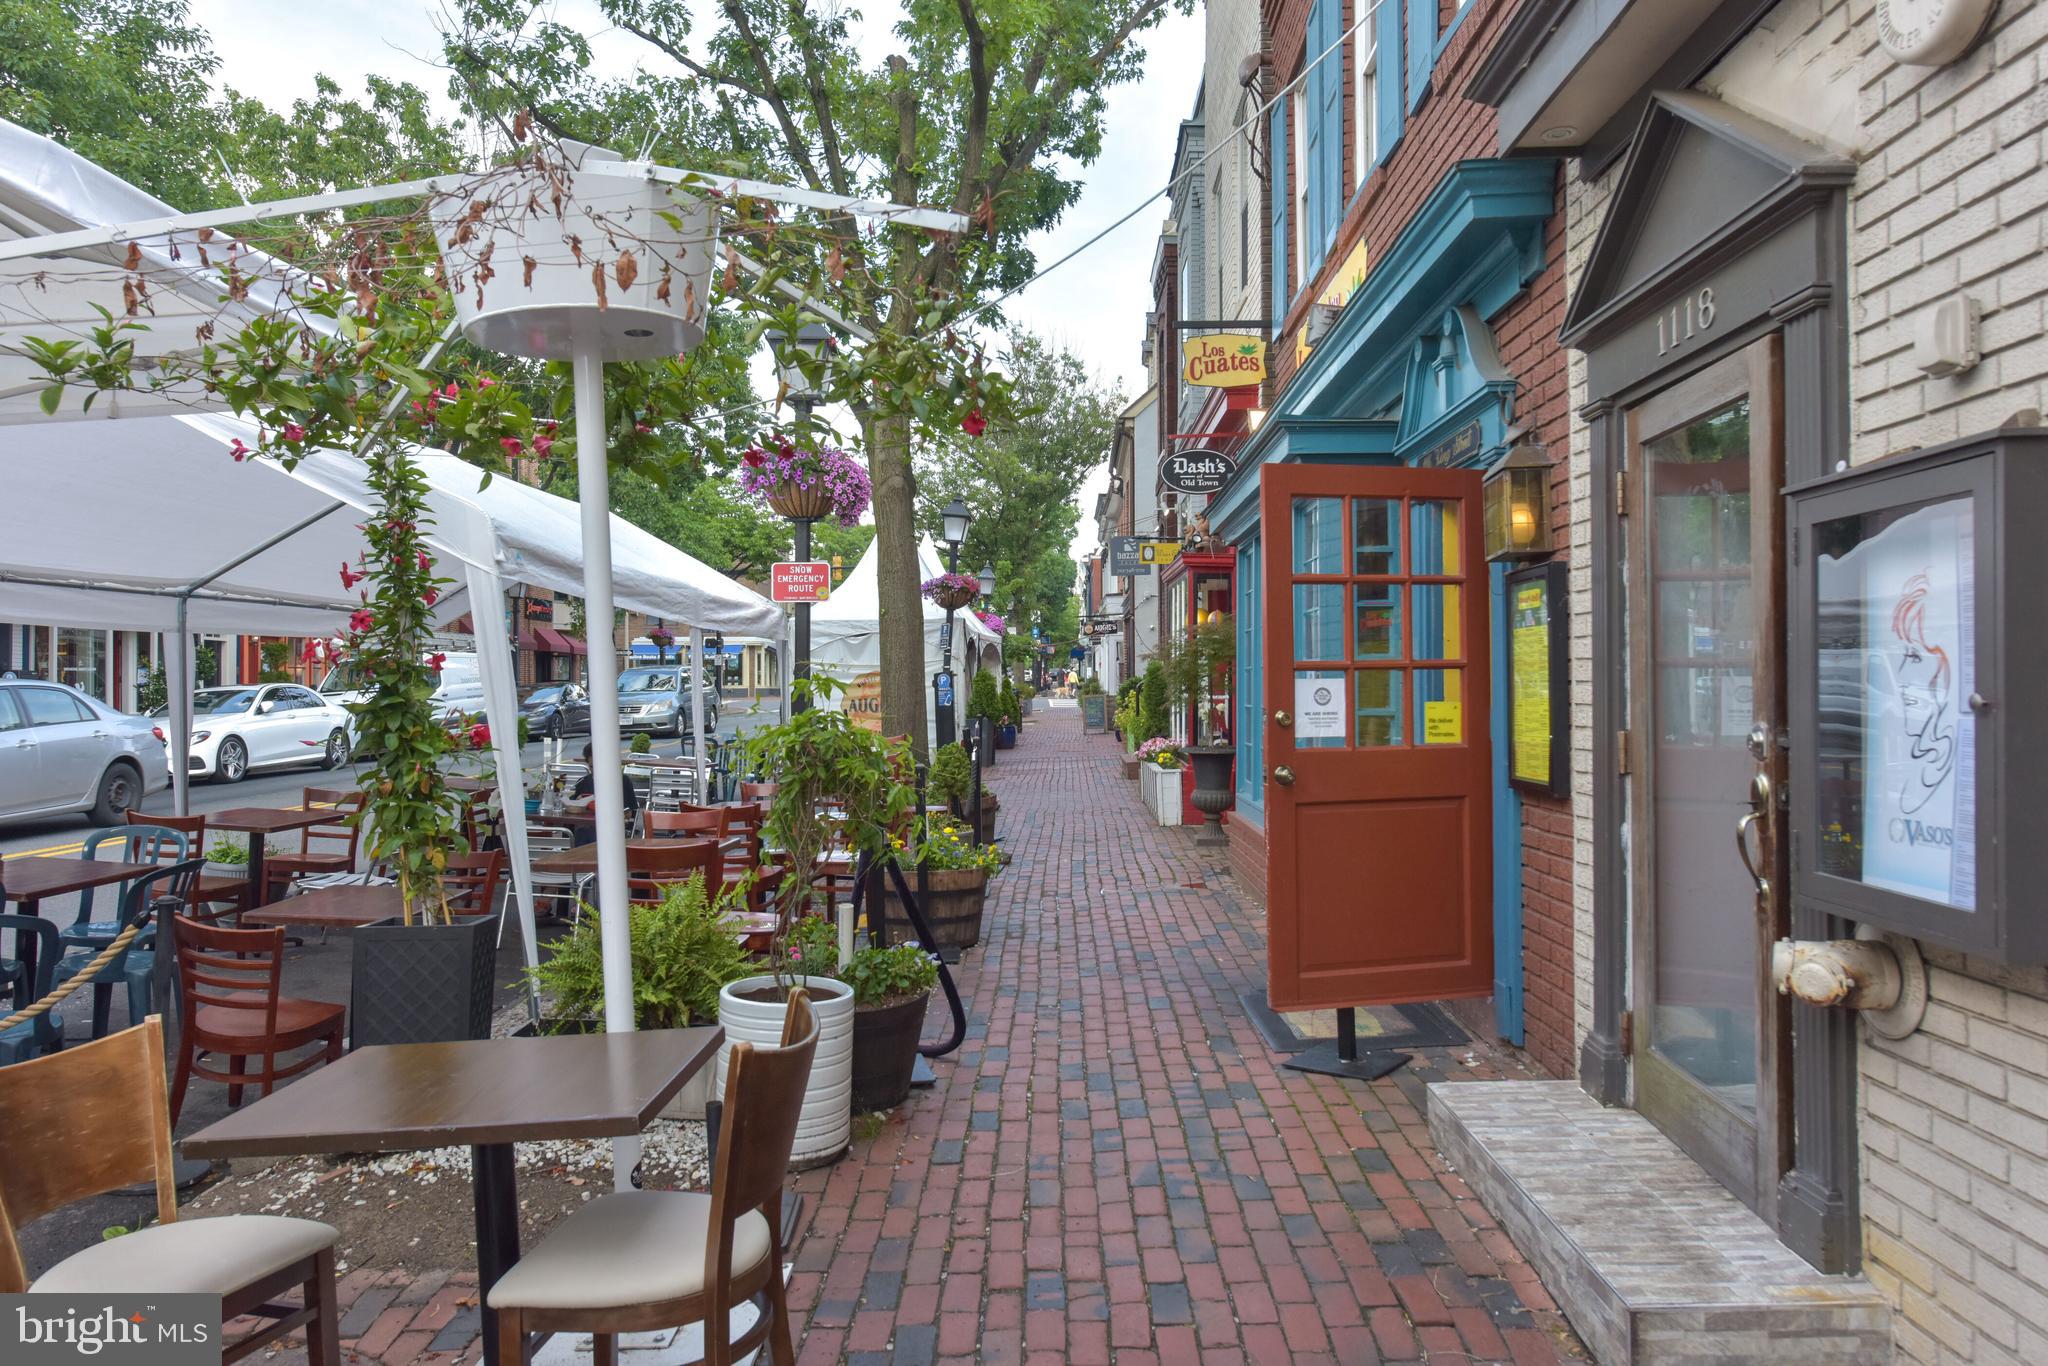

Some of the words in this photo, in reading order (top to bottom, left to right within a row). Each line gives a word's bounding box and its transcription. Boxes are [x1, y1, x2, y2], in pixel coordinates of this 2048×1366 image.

[1656, 287, 1715, 357] 1118
[1201, 341, 1225, 358] Los
[1189, 352, 1260, 381] Cuates
[1173, 458, 1226, 474] Dash's
[789, 566, 813, 574] SNOW
[777, 575, 825, 583] EMERGENCY
[788, 584, 814, 592] ROUTE
[849, 698, 879, 713] AUG
